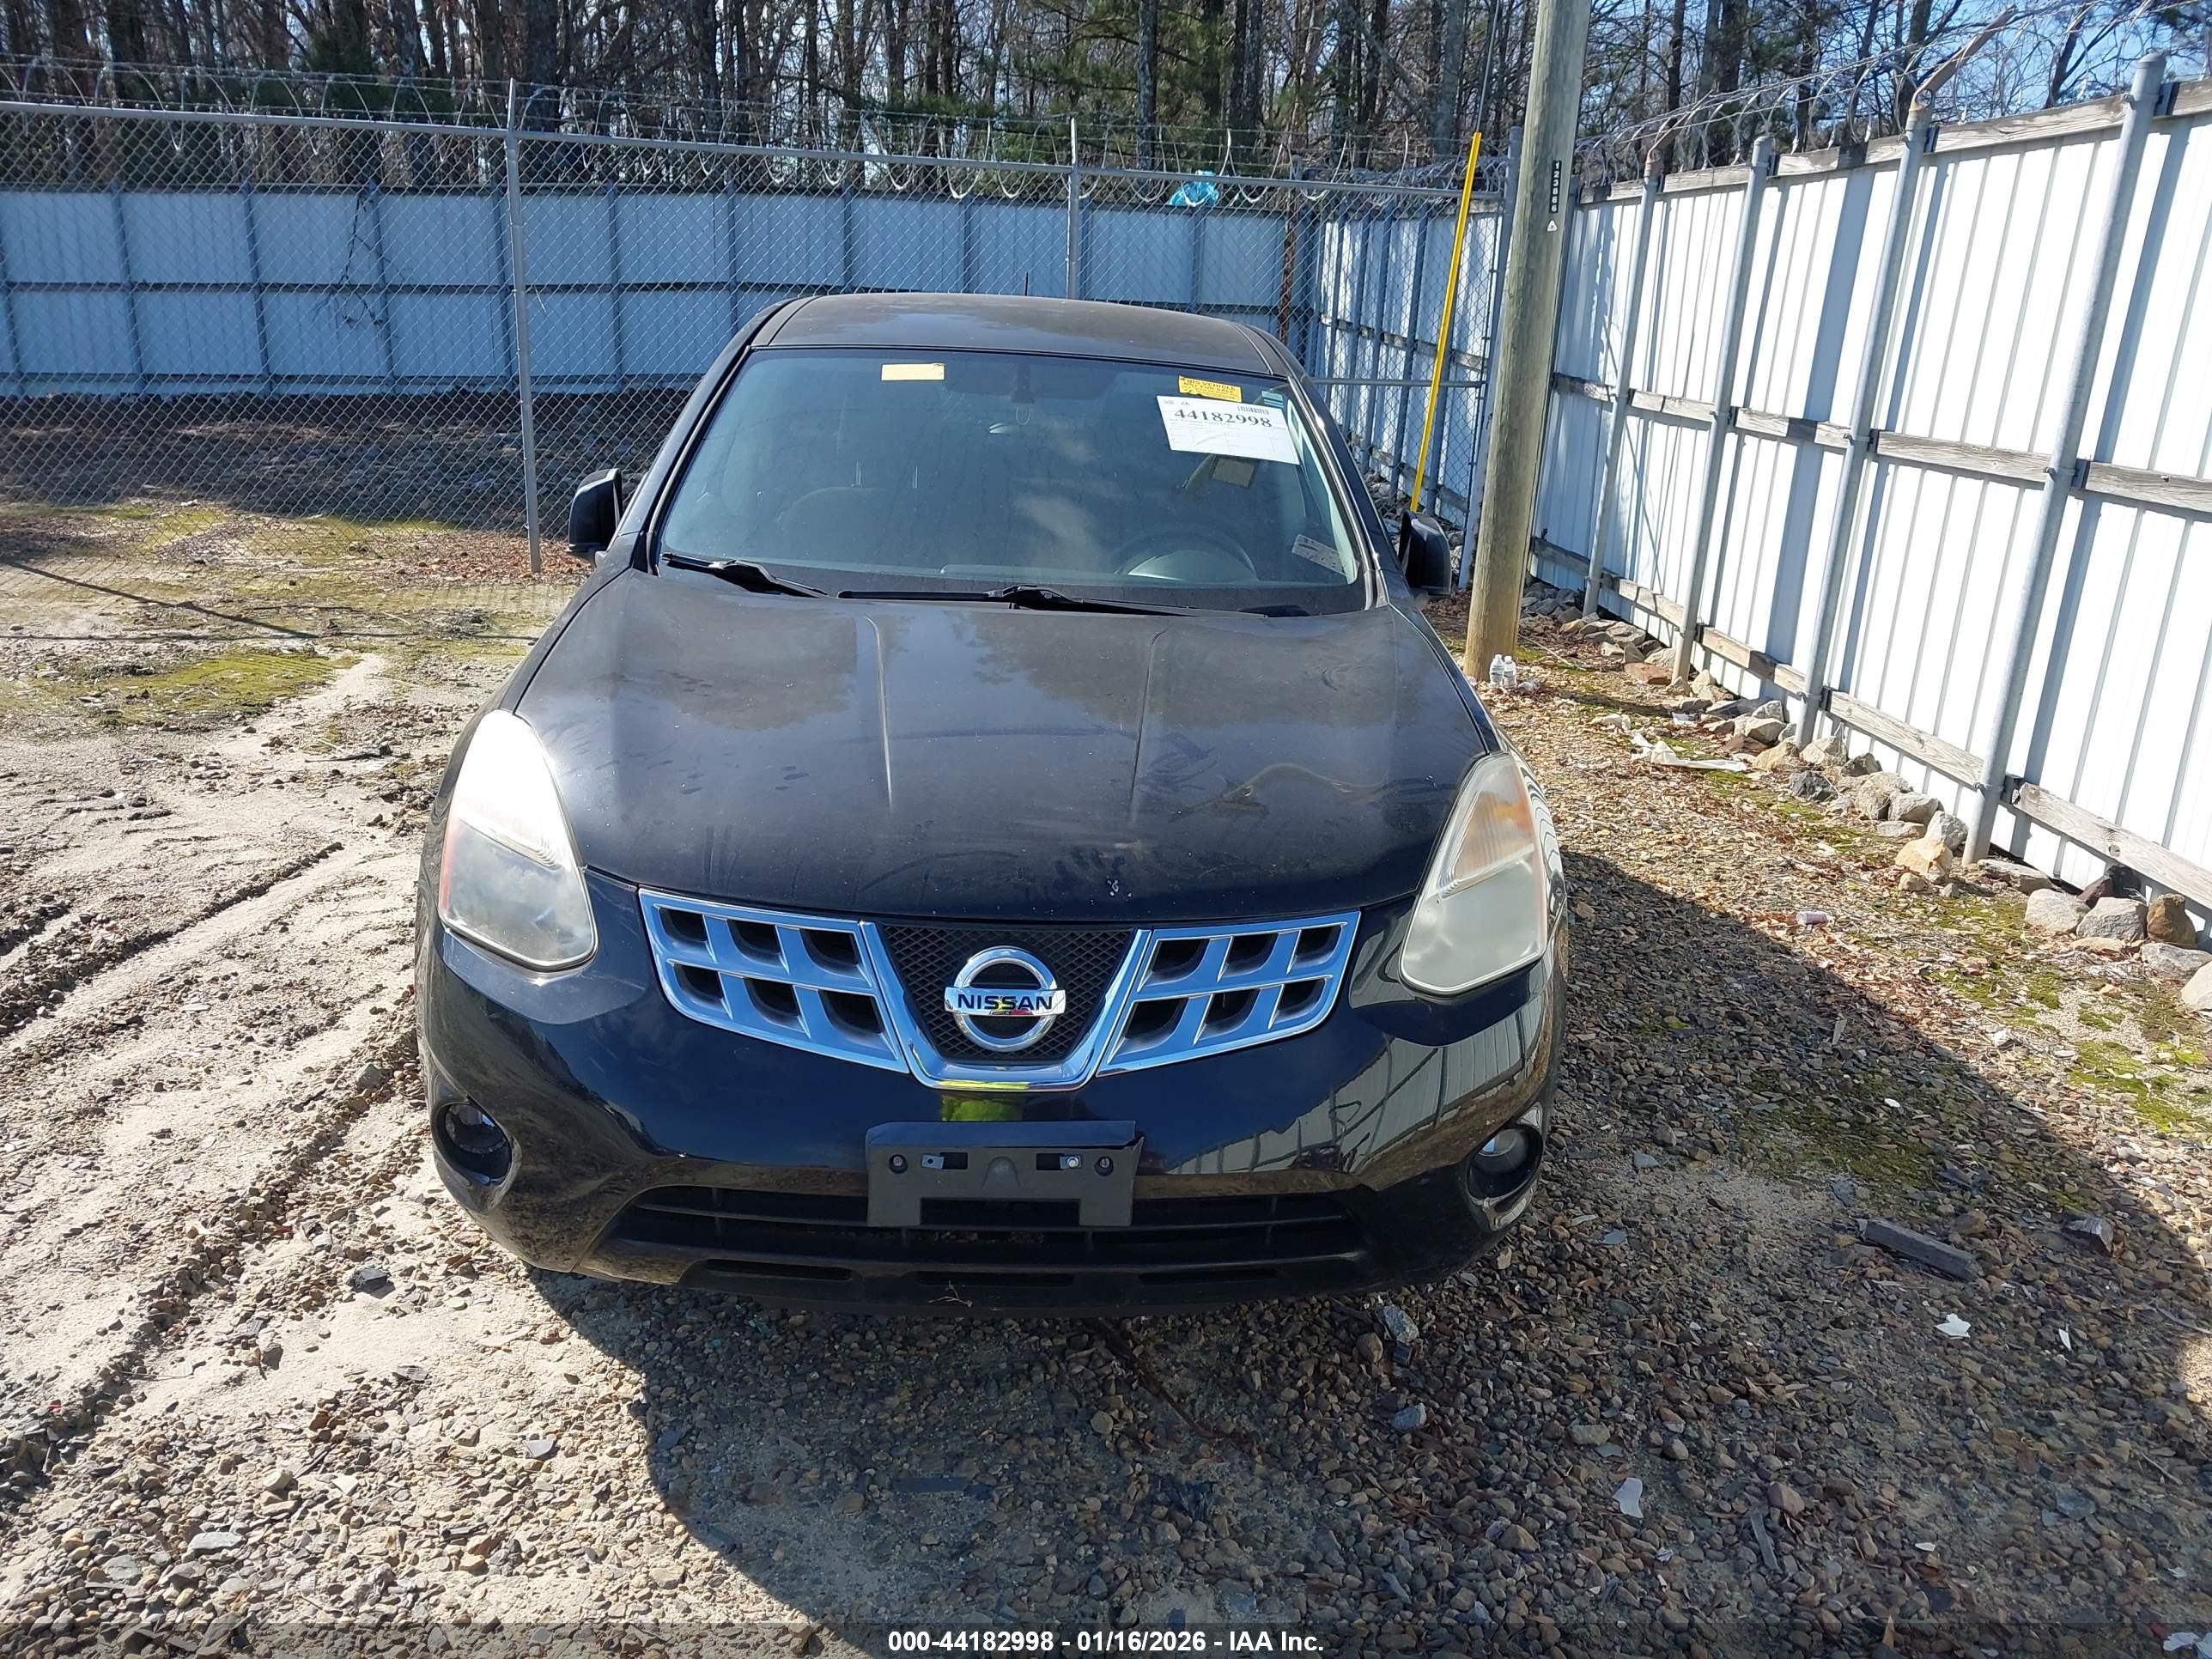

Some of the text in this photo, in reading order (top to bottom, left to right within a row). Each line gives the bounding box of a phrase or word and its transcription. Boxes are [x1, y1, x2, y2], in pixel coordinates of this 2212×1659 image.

[1202, 381, 1236, 390] VEHICLE
[1175, 409, 1273, 428] 44182998
[957, 994, 1053, 1010] NISSAN
